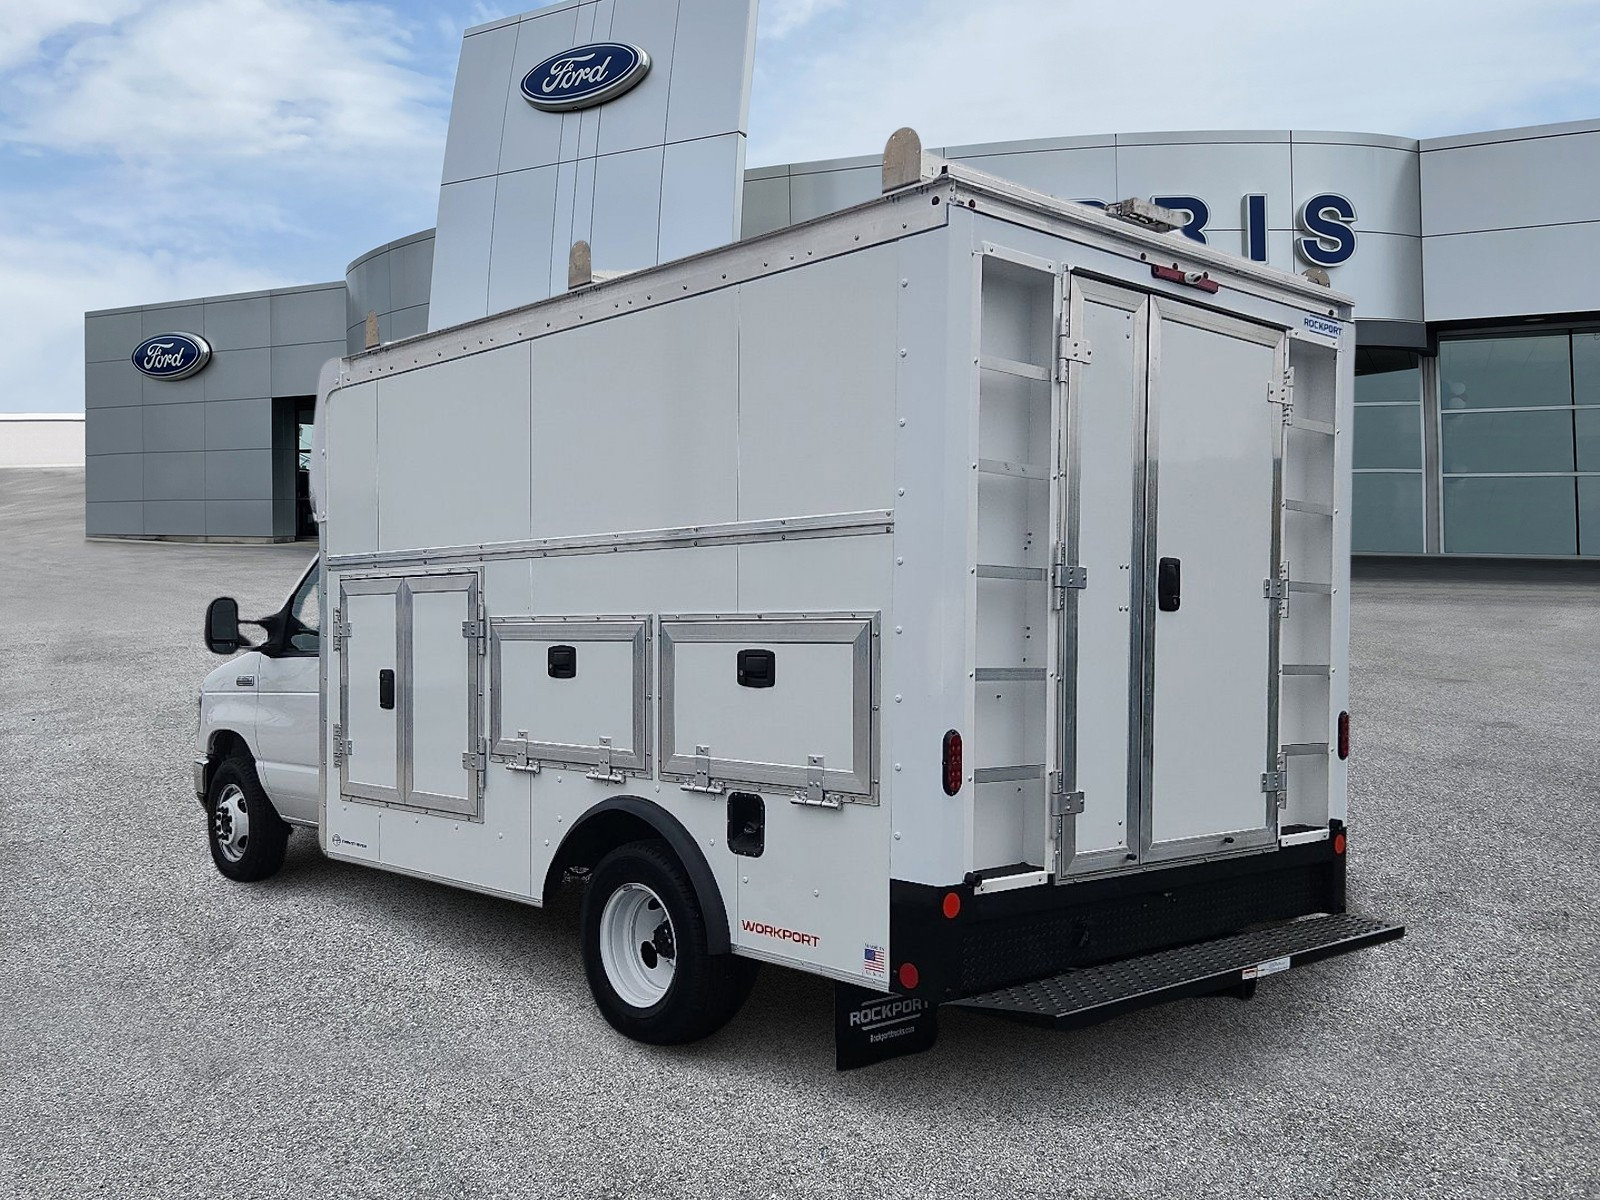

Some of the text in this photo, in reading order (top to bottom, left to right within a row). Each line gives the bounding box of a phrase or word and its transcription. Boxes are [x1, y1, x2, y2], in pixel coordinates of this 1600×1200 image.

[542, 53, 612, 93] Ford
[1074, 190, 1358, 268] RIS
[1304, 317, 1343, 336] ROCKPORT
[143, 343, 185, 369] Ford
[741, 919, 821, 947] WORKPORT
